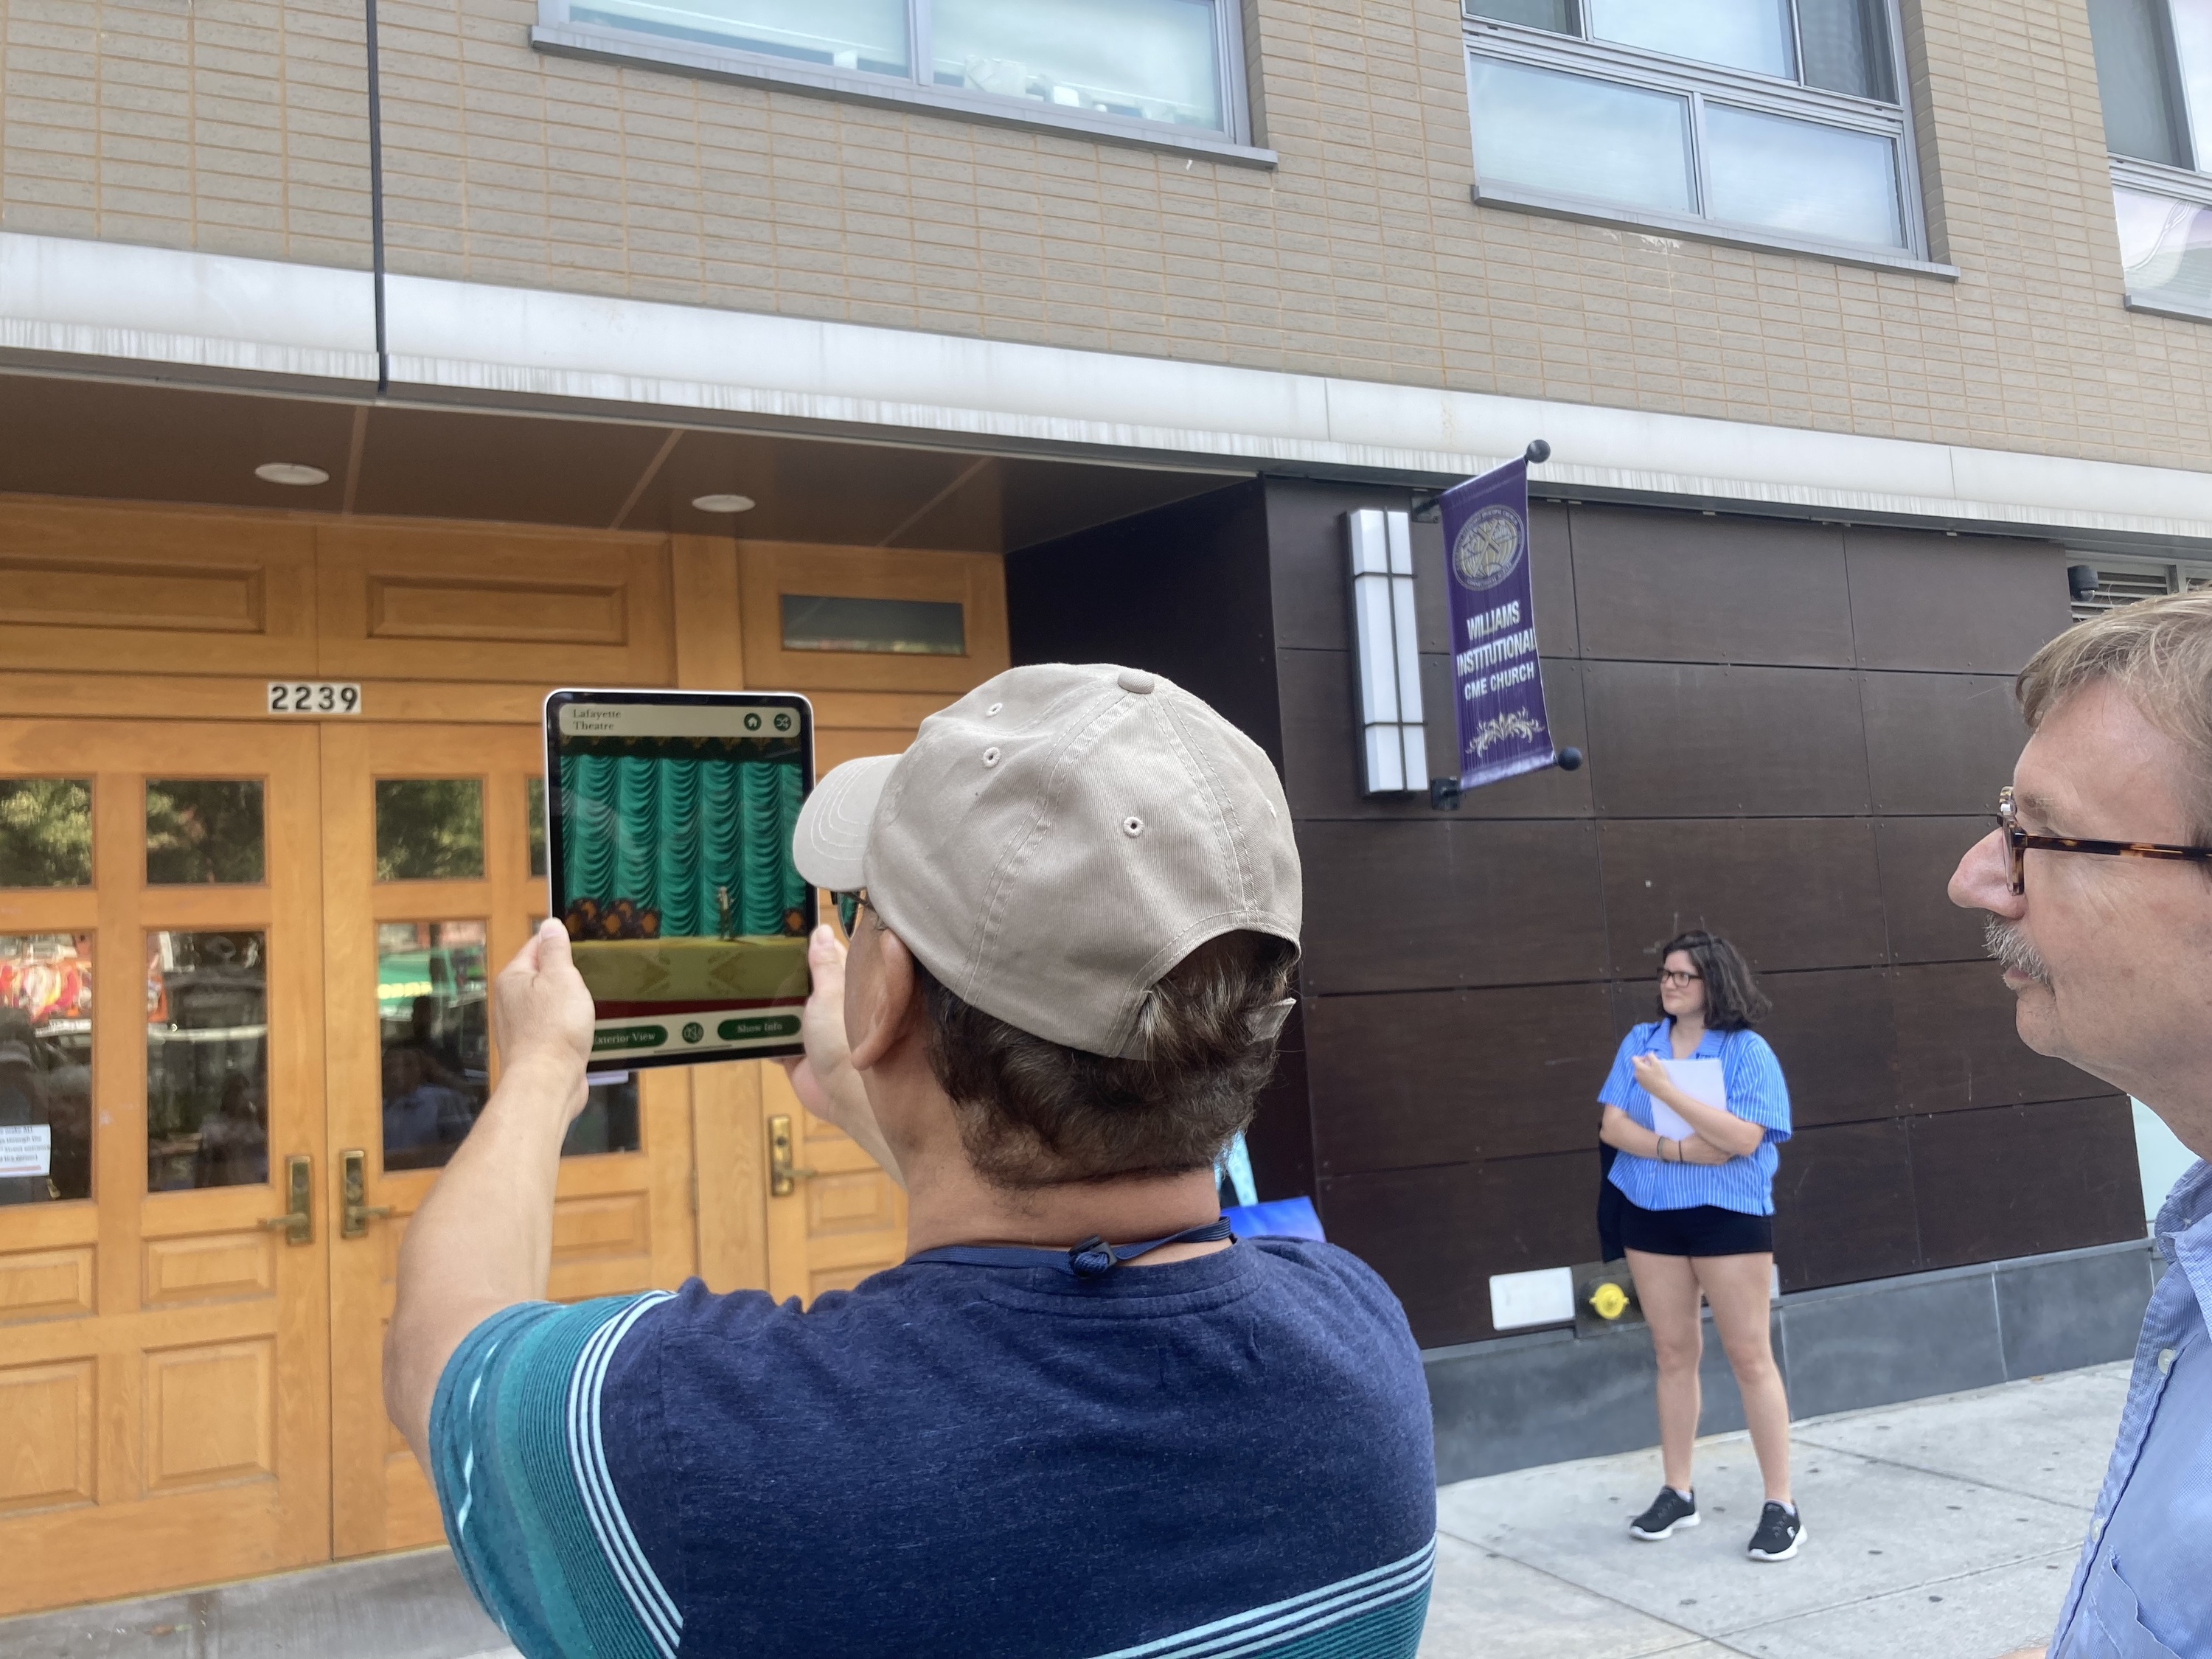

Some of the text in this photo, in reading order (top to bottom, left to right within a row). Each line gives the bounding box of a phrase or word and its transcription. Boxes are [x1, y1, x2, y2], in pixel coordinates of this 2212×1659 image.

[1467, 600, 1520, 641] WILLIAMS
[1456, 627, 1536, 678] INSTITUTIONAL
[1464, 661, 1534, 700] CME CHURCH
[271, 686, 359, 712] 2239
[573, 709, 622, 720] Lafayette
[573, 720, 614, 730] Theatre
[737, 1022, 783, 1033] Show Info
[632, 1032, 655, 1042] View
